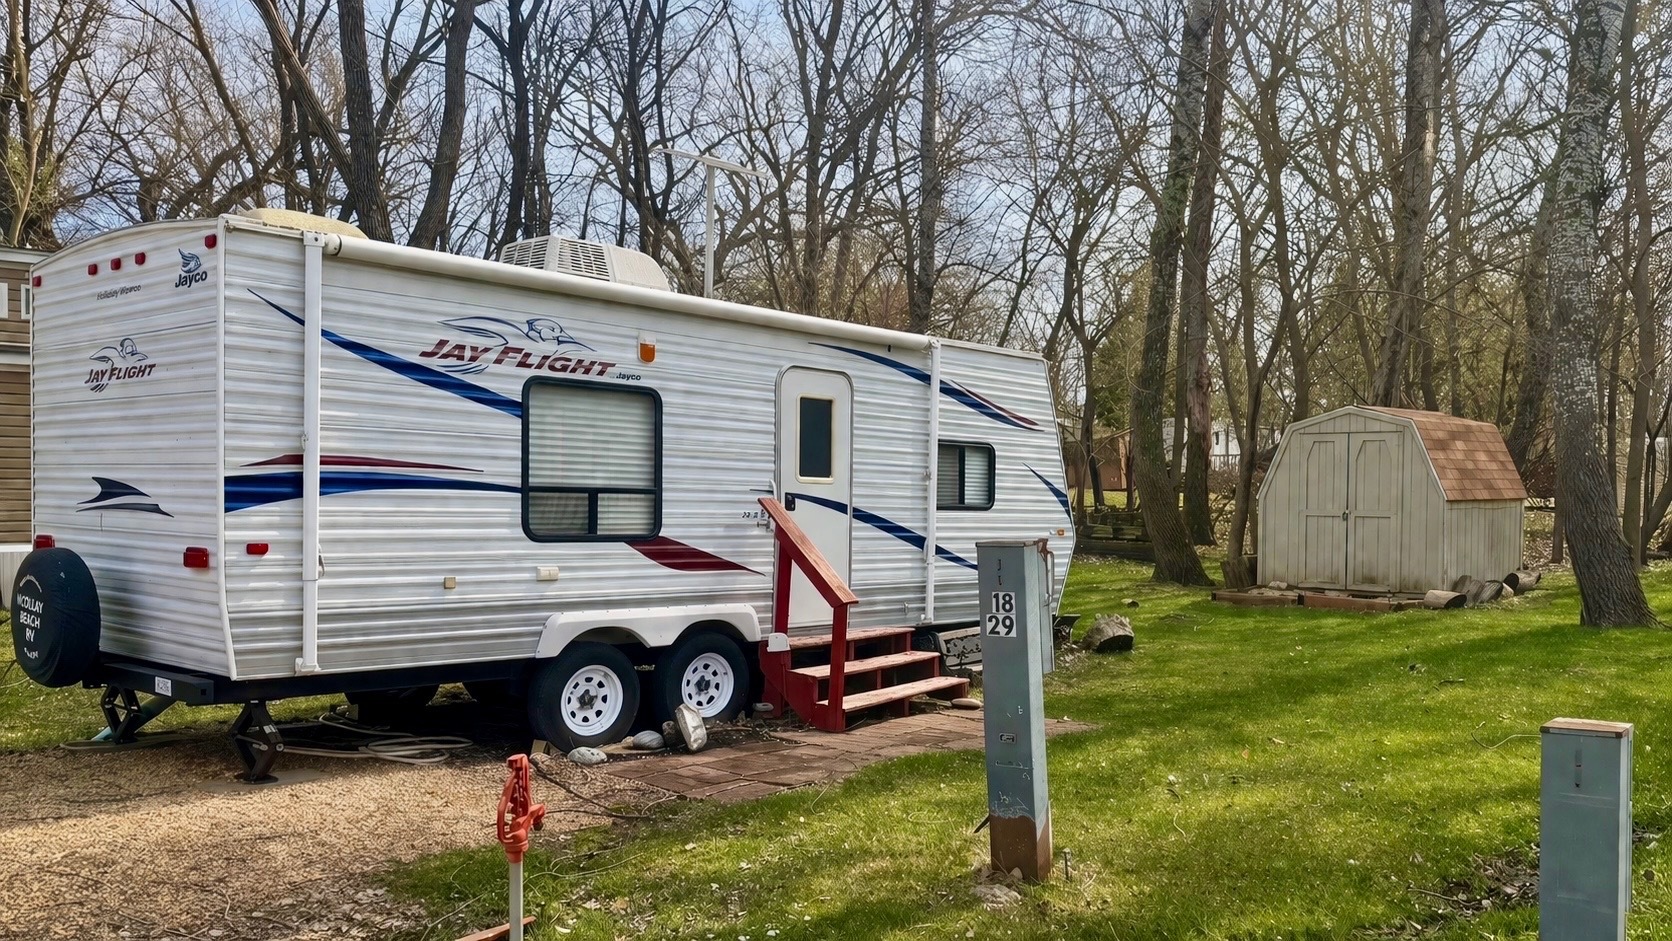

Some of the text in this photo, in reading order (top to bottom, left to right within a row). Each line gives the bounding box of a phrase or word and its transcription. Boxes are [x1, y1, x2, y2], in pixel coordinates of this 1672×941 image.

[174, 270, 208, 288] Jayco
[418, 338, 494, 364] JAY
[492, 345, 617, 377] FLIGHT
[84, 363, 157, 385] JAY FLIGHT
[993, 592, 1014, 613] 18
[20, 611, 41, 629] BEACH
[988, 615, 1014, 636] 29
